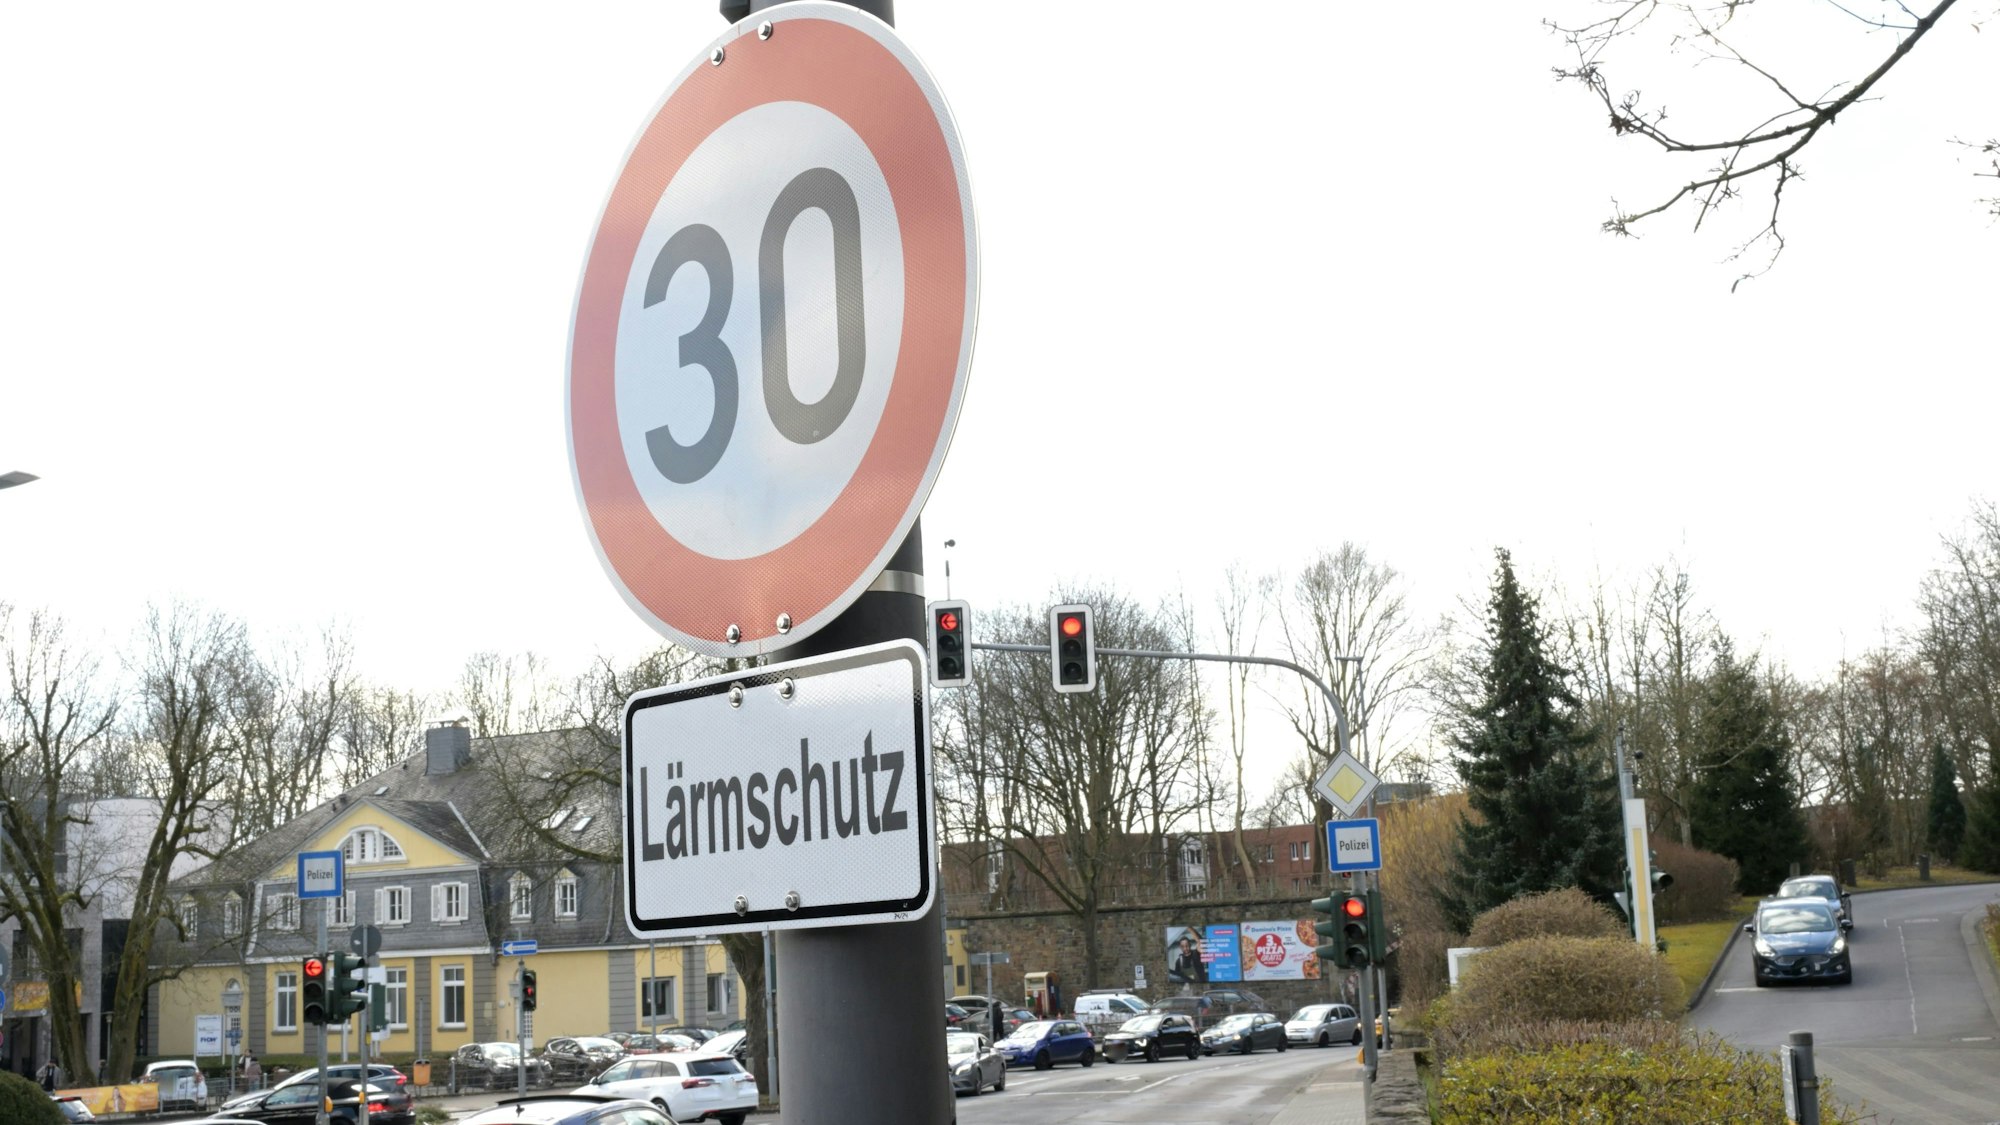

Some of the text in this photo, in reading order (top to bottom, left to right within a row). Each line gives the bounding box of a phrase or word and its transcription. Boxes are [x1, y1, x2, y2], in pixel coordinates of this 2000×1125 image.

[643, 167, 866, 485] 30
[640, 730, 908, 862] Lärmschutz
[1339, 839, 1370, 852] Polizei
[307, 868, 333, 880] Polizei
[1265, 934, 1275, 947] 3.
[1256, 946, 1284, 955] PIZZA
